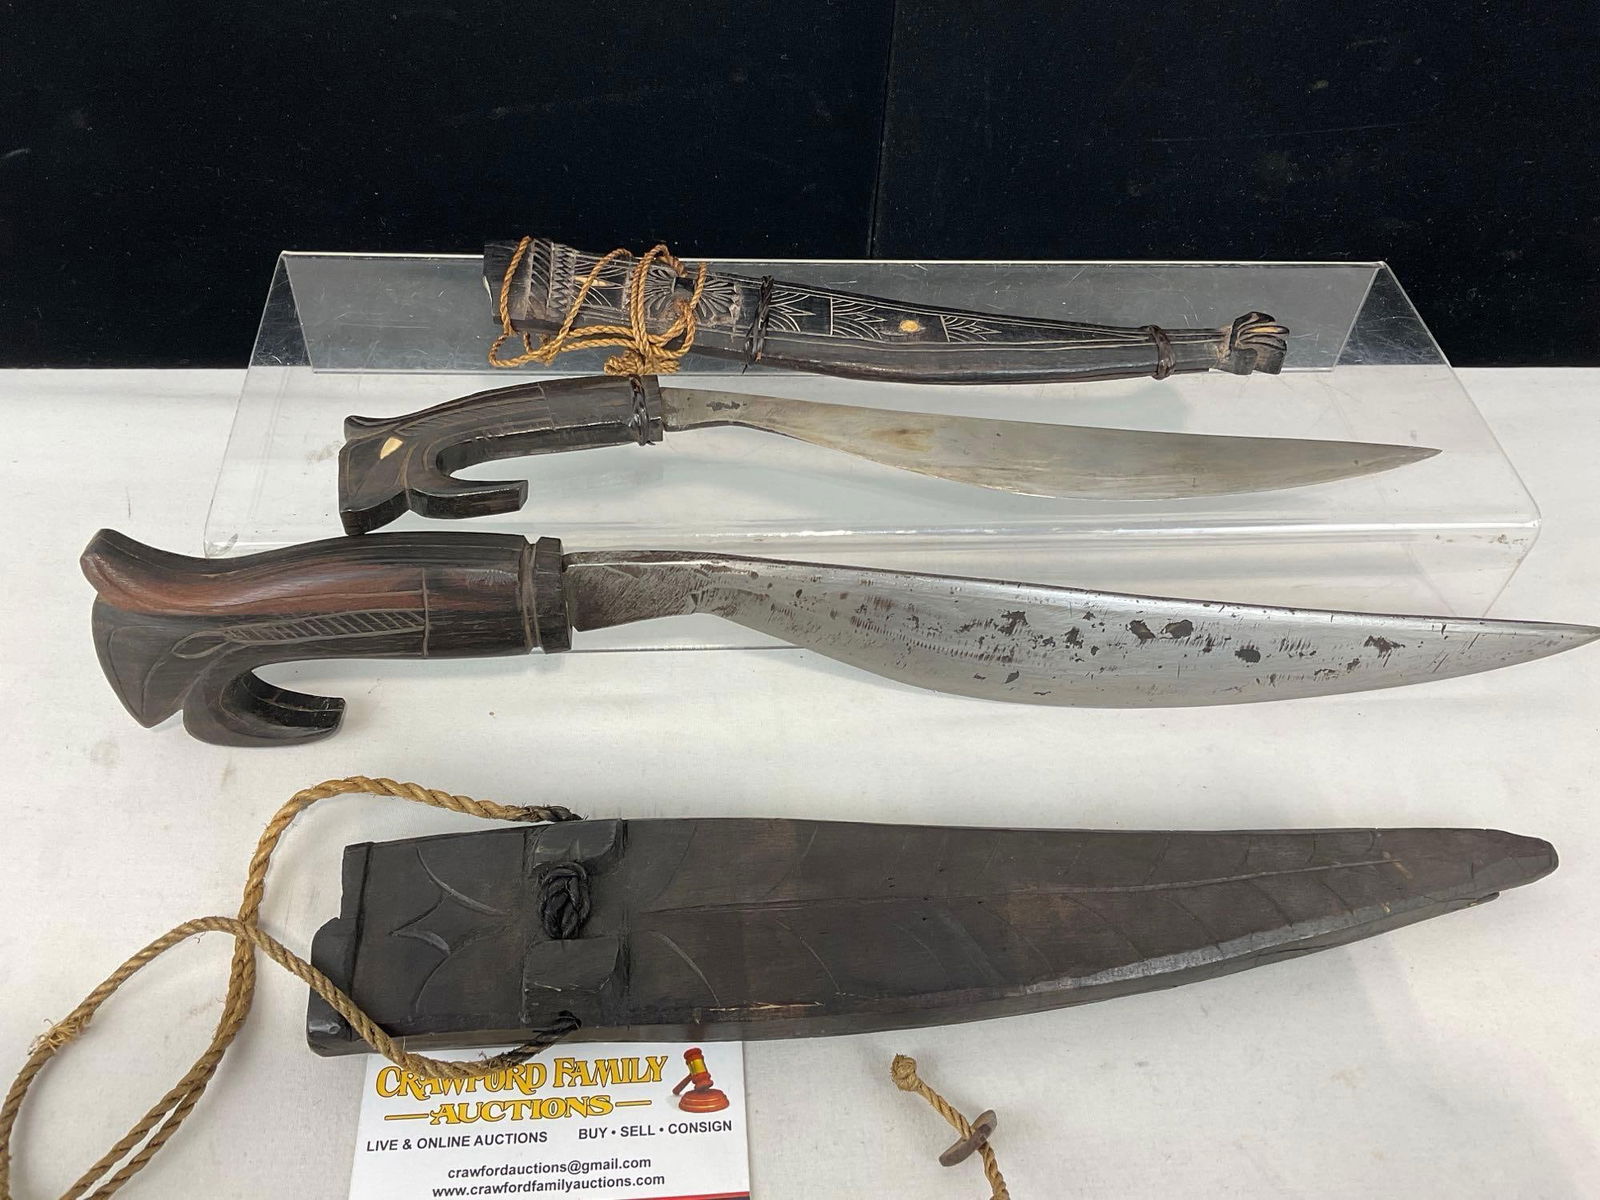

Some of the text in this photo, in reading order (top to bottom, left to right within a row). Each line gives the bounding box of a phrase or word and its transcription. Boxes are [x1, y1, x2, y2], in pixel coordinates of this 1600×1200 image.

[552, 1055, 669, 1088] FAMILY
[429, 1094, 614, 1126] AUCTIONS
[366, 1131, 549, 1152] LIVE & ONLINE AUCTIONS
[578, 1120, 733, 1140] BUY SELL CONSIGN
[447, 1157, 652, 1179] crawfordauctions@gmail.com
[432, 1174, 665, 1198] www.crawfordfamilyauctions.com
